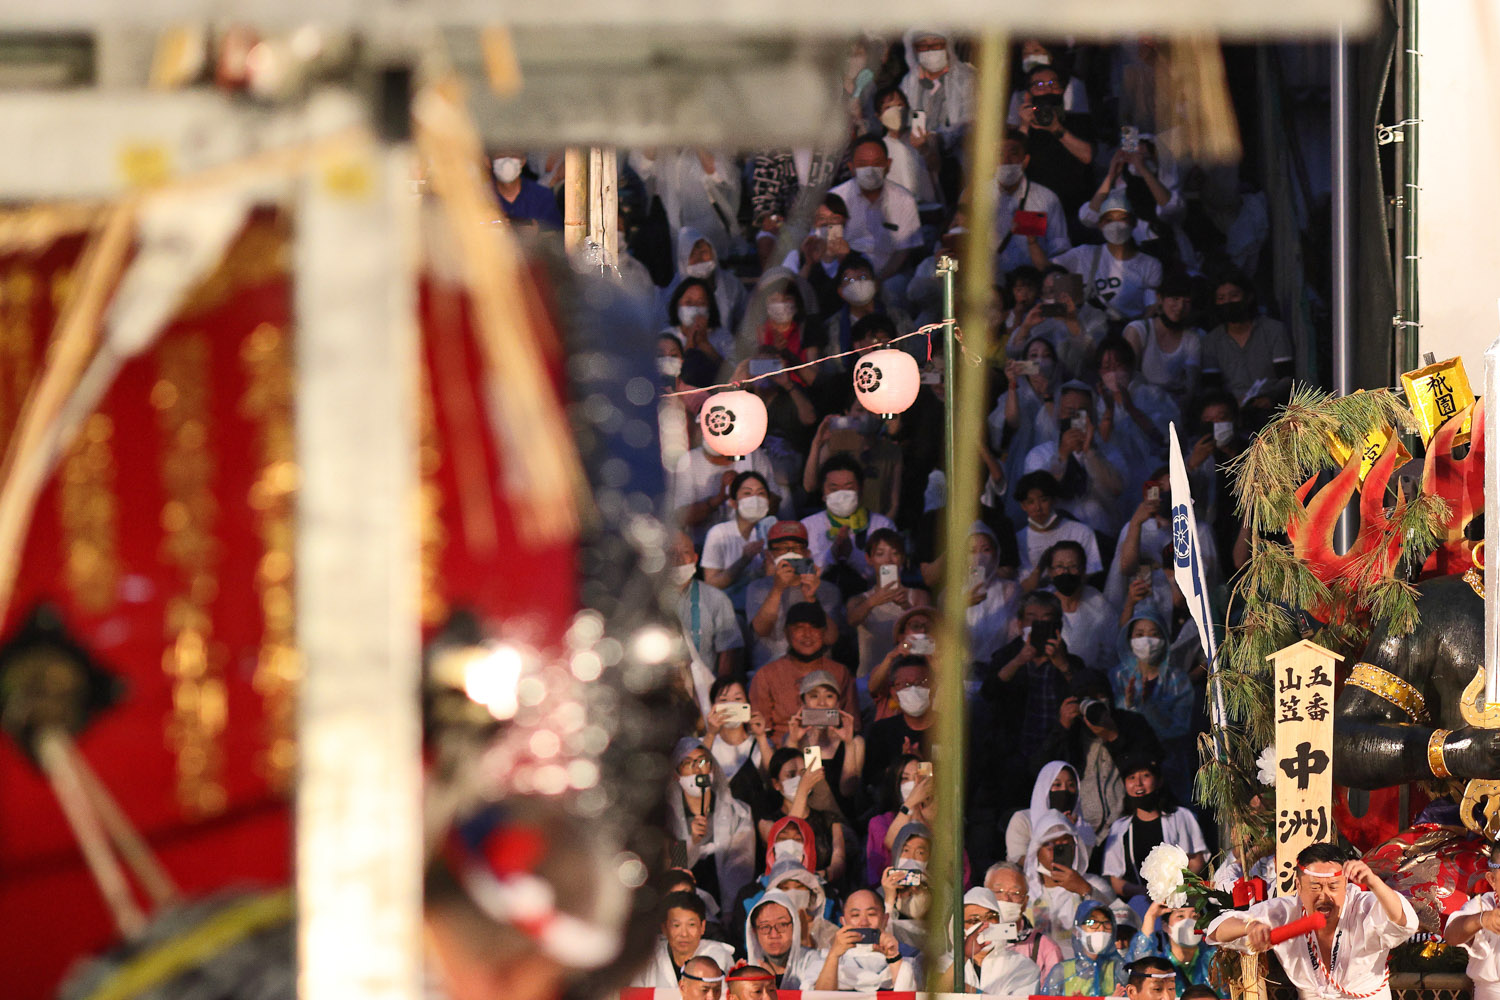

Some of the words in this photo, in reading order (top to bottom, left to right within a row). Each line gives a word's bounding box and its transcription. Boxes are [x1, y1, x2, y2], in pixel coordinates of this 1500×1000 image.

[1426, 372, 1457, 425] 祇園
[1278, 666, 1304, 725] 山笠
[1305, 664, 1333, 722] 五番
